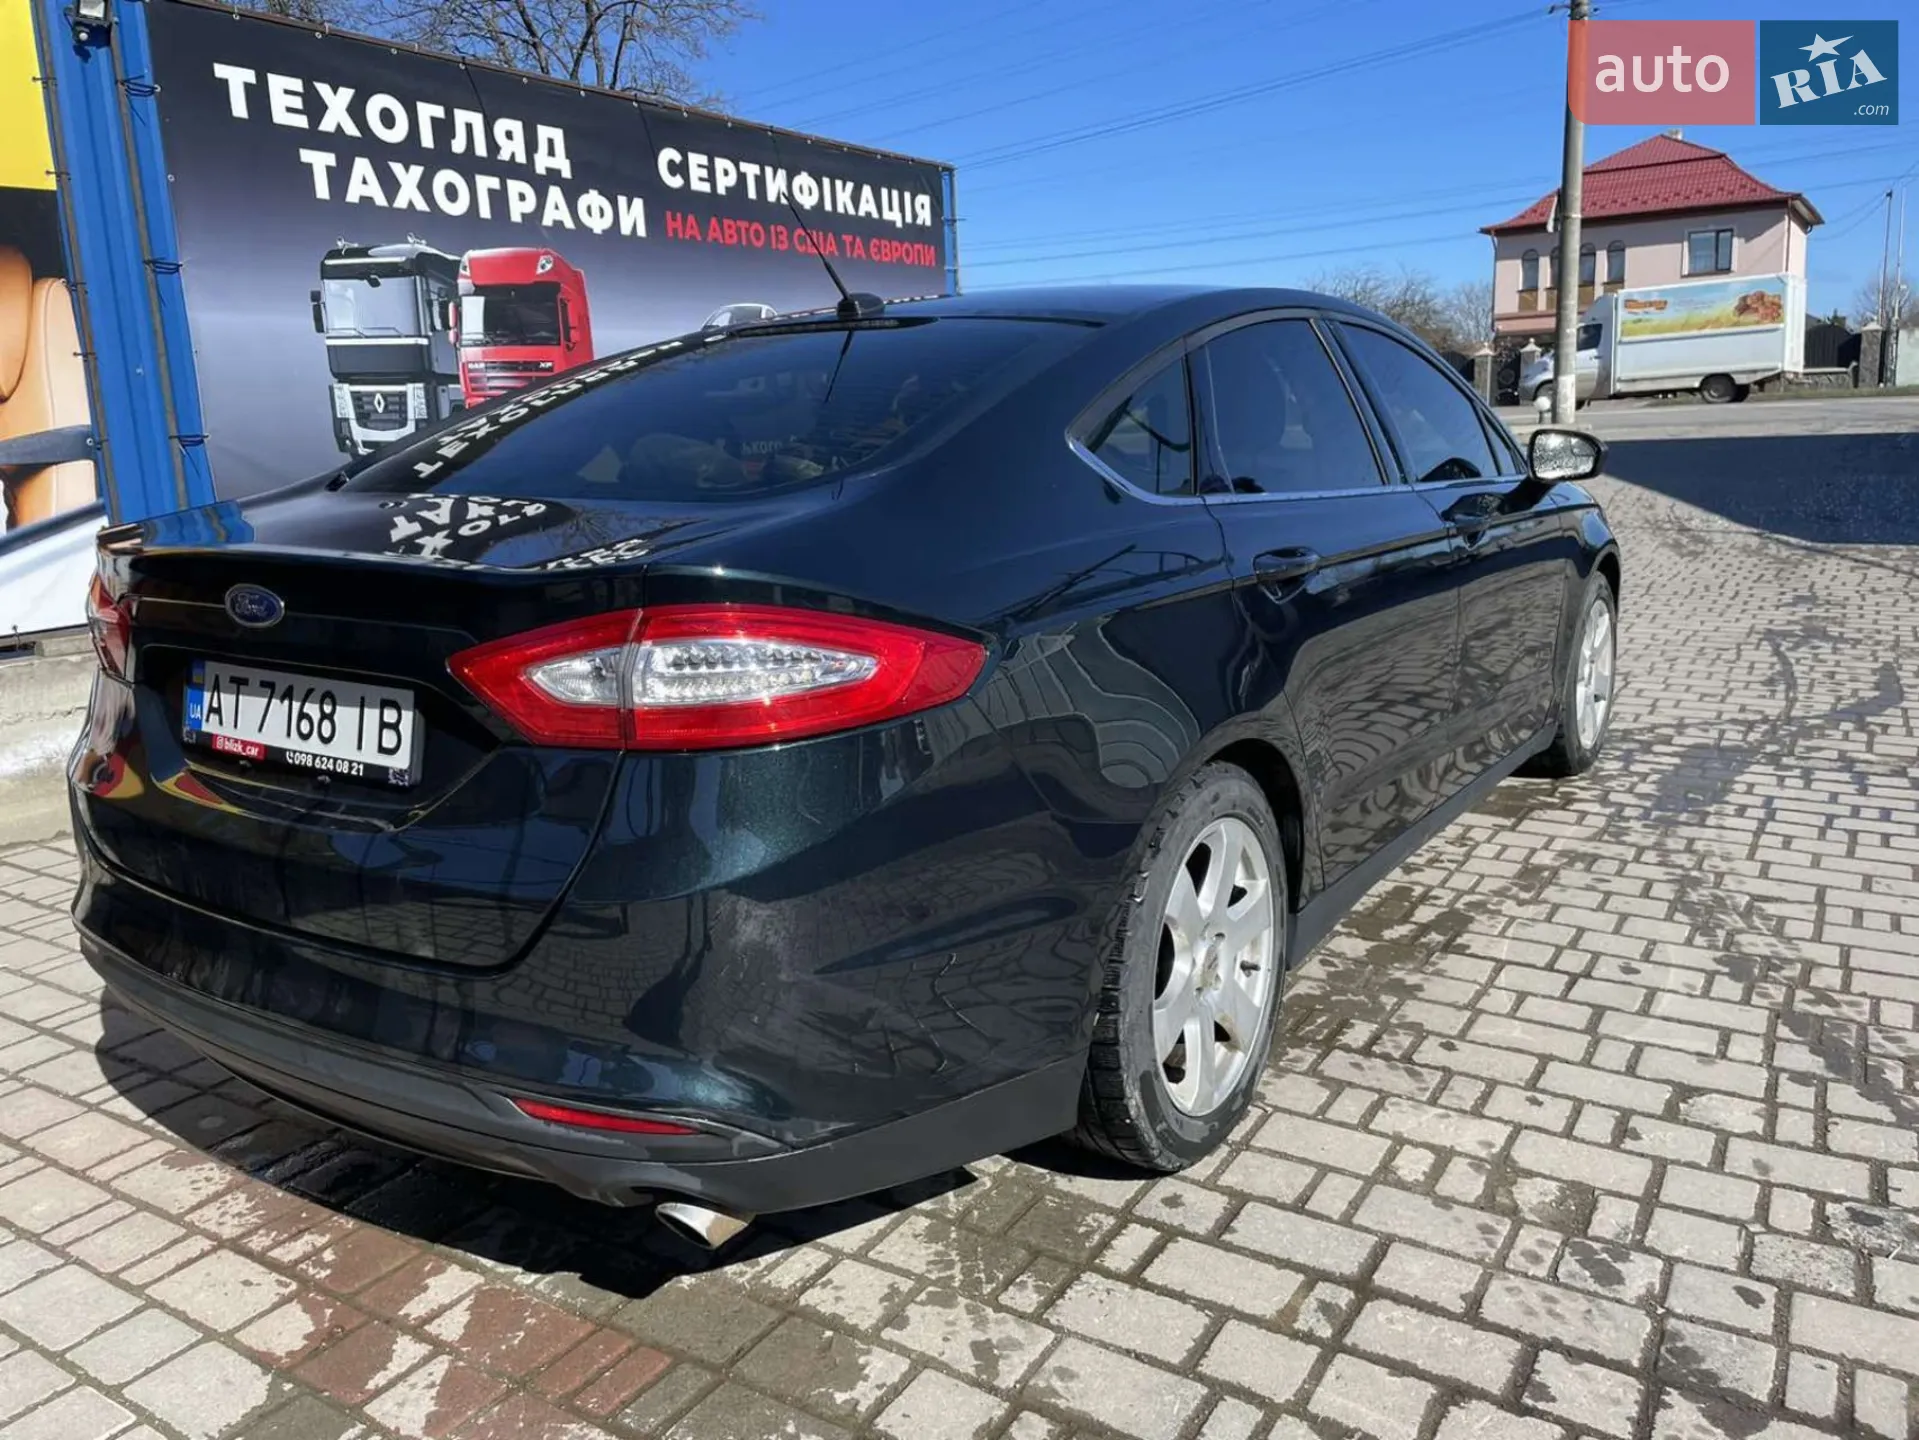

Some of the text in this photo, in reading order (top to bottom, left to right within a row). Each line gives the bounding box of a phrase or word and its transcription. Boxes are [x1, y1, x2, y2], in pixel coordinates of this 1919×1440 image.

[213, 62, 573, 180] ТЕХОГЛЯД
[299, 148, 647, 239] ТАХОГРАФИ
[656, 147, 933, 228] СЕРТИФІКАЦІЯ
[665, 210, 936, 268] НА АВТО ІЗ США ТА ЄВРОПИ
[189, 674, 403, 757] UA AT 7168 IB
[294, 752, 364, 777] 098 624 08 21
